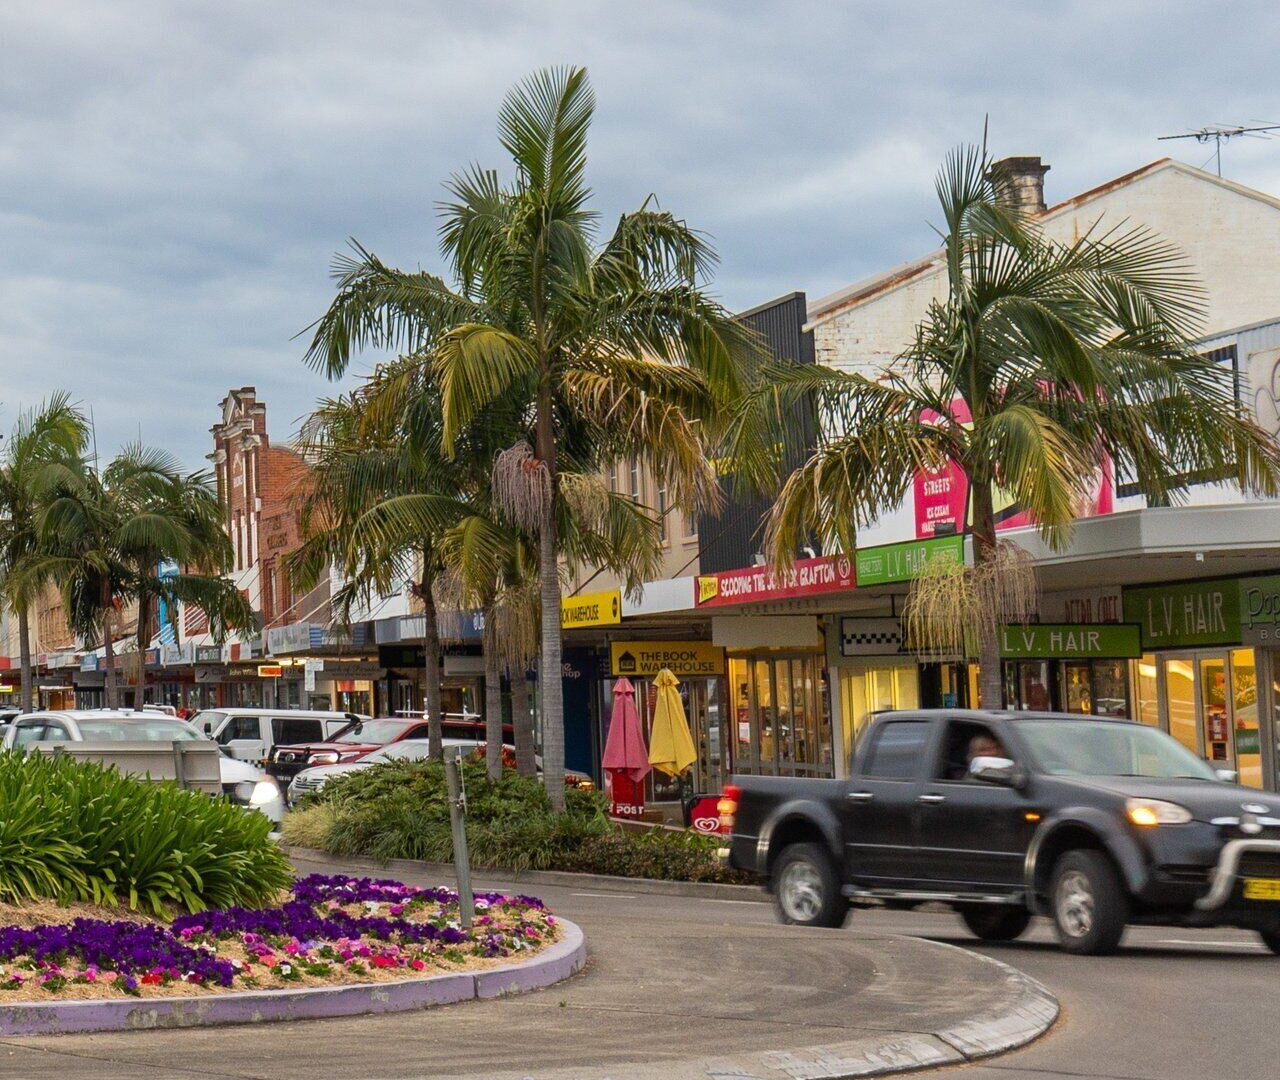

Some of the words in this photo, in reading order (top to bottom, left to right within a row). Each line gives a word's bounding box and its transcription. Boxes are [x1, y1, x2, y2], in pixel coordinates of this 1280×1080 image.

[924, 478, 950, 496] STREETS
[721, 576, 752, 597] SCOOPING
[800, 563, 835, 586] GRAFTON
[1184, 592, 1226, 634] HAIR
[1050, 631, 1102, 652] HAIR
[640, 652, 662, 662] THE
[664, 651, 697, 662] BOOK
[640, 662, 714, 672] WAREHOUSE
[616, 806, 644, 815] POST
